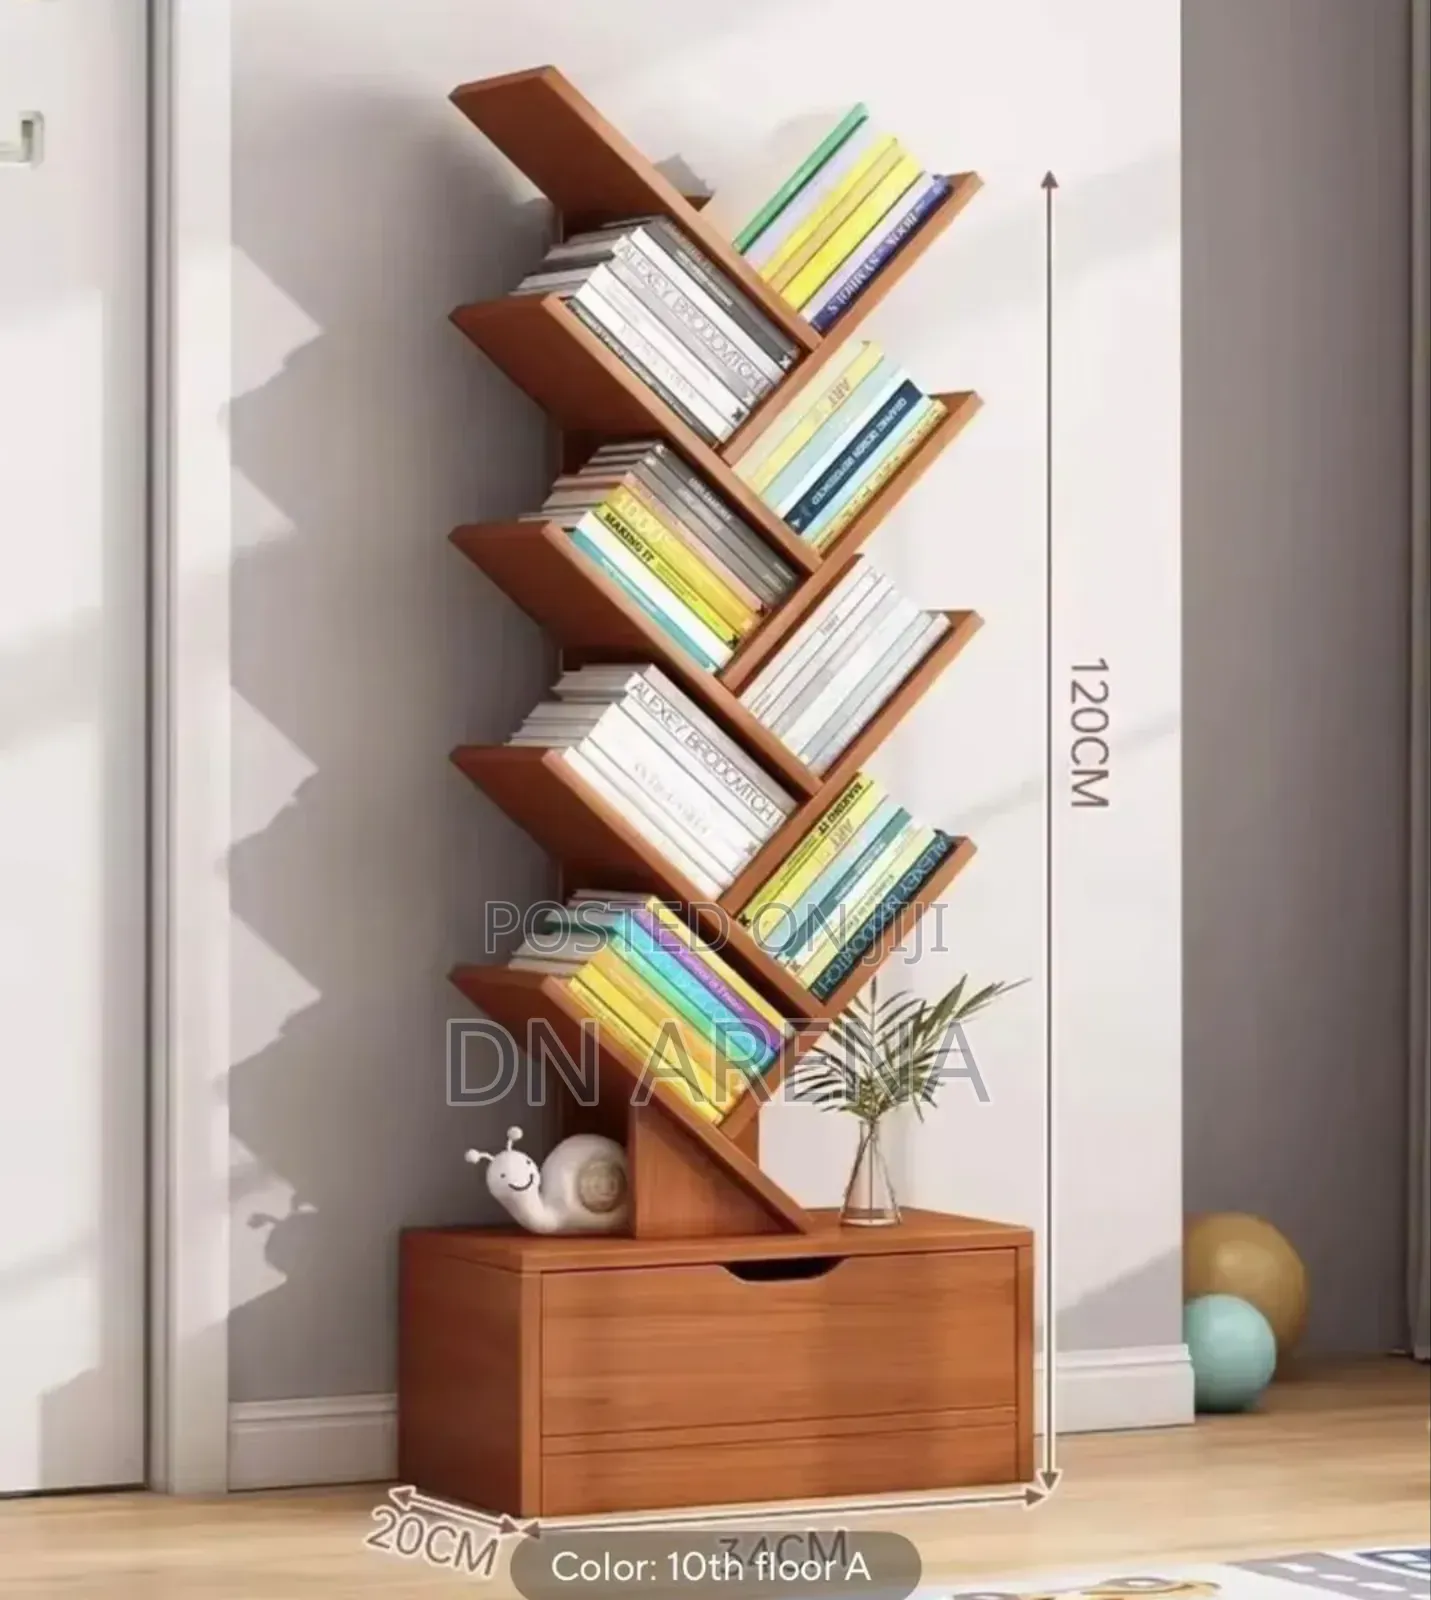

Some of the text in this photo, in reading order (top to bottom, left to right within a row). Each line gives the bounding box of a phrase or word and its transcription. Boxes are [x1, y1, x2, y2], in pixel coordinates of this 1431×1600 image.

[620, 244, 675, 298] ALEXEY
[604, 512, 655, 563] MAKING IT
[631, 681, 687, 736] ALEXEY
[684, 730, 776, 823] BRODOVITCH
[818, 820, 831, 835] IT
[827, 782, 864, 824] MAKING
